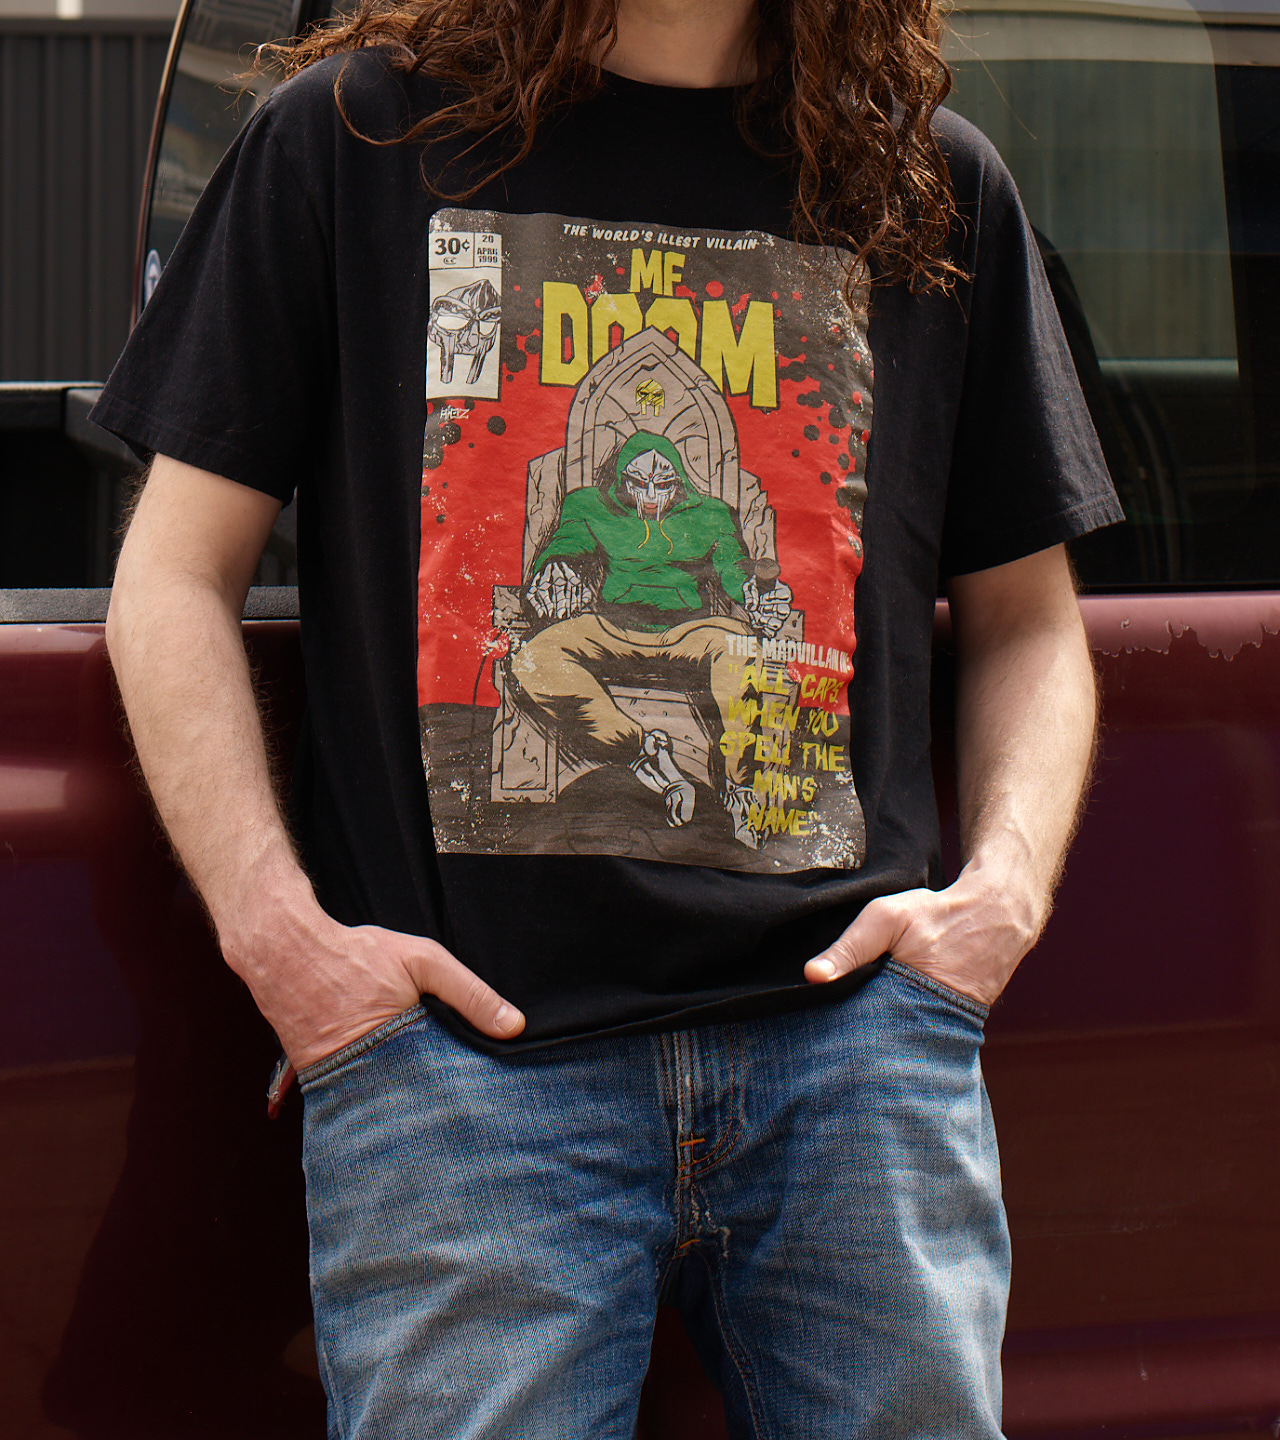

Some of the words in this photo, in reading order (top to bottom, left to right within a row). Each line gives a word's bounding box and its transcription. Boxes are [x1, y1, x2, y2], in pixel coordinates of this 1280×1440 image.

[563, 223, 588, 236] THE
[592, 229, 653, 243] WORLD'S
[657, 234, 701, 249] ILLEST
[706, 237, 759, 251] VILLAIN
[477, 255, 498, 264] 1999
[629, 247, 686, 297] MF
[540, 281, 779, 409] DOOM
[725, 634, 757, 657] THE
[801, 674, 845, 703] CAPS
[727, 695, 800, 732] WHEN
[805, 708, 839, 737] YOU
[719, 731, 791, 766] SPELL
[801, 742, 846, 772] THE
[753, 769, 815, 802] MAN'S
